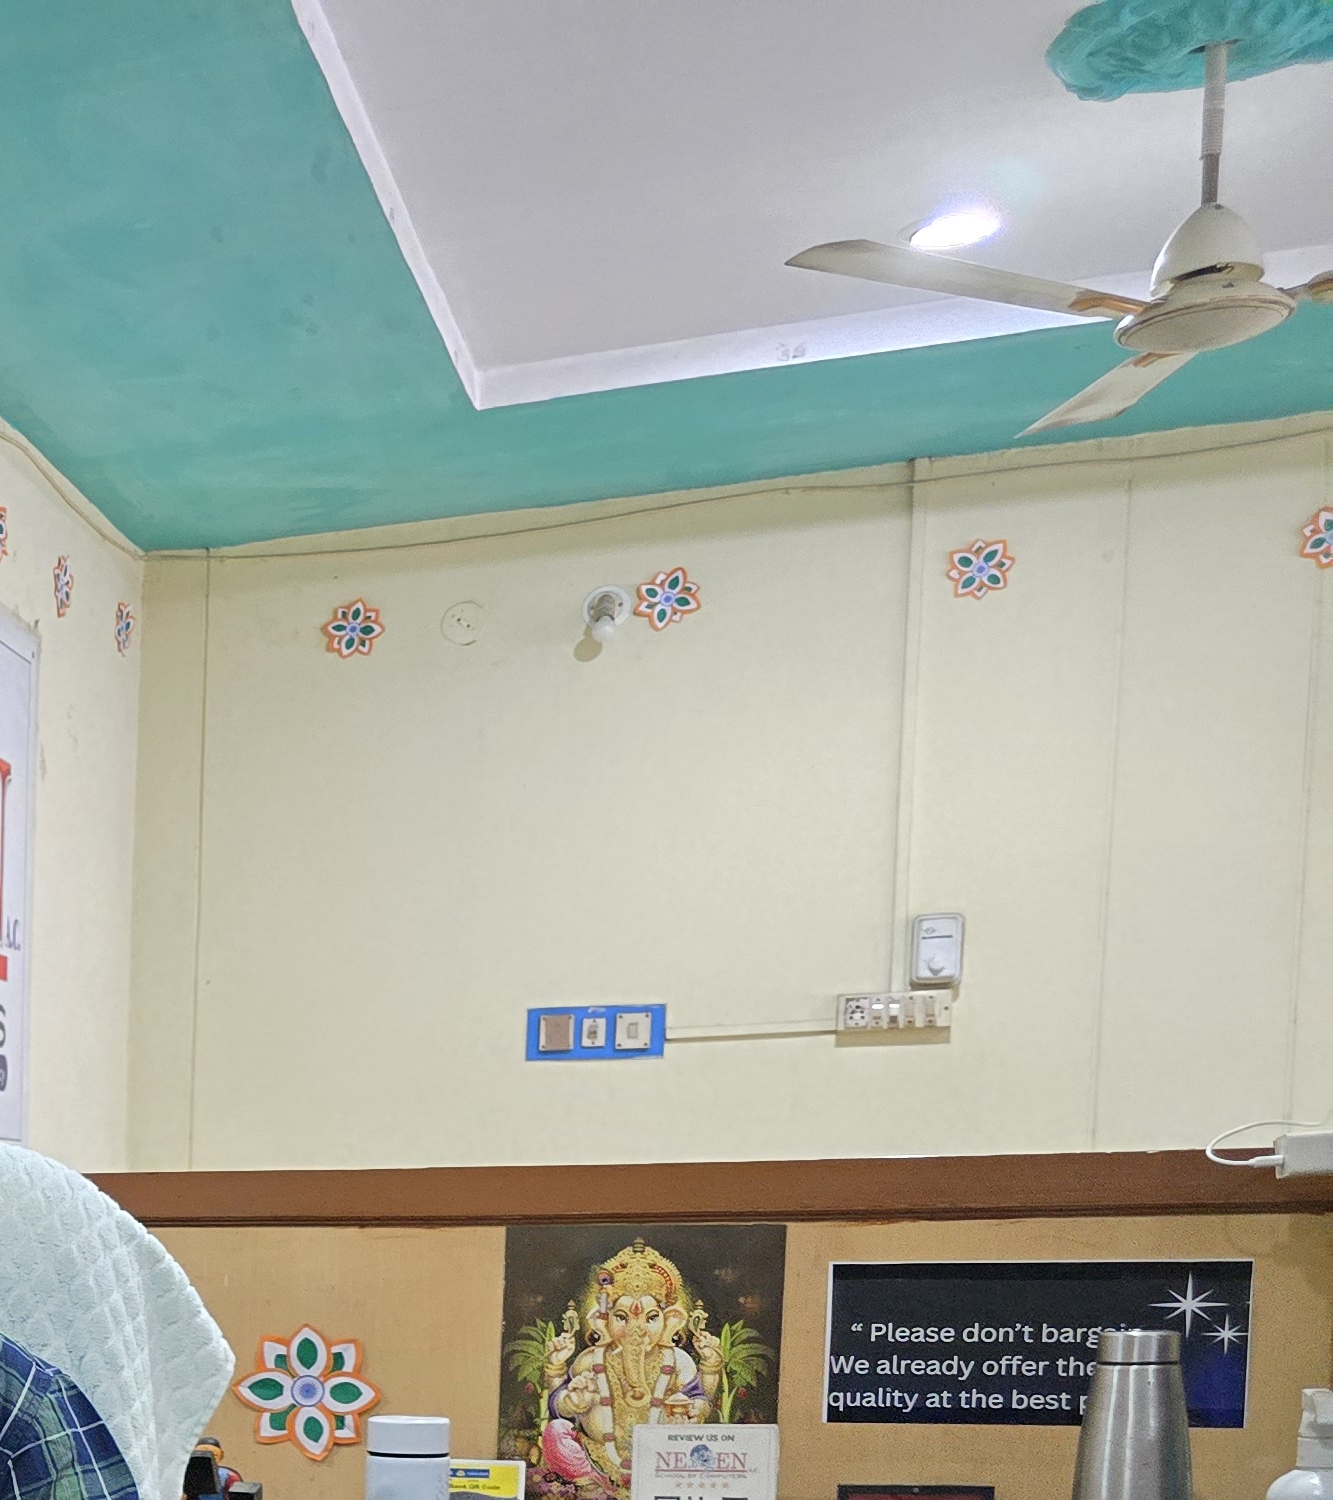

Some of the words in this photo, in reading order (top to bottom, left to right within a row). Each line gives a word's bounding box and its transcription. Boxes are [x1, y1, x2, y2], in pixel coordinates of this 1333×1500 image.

[870, 1322, 955, 1343] Please
[830, 1355, 870, 1375] We
[876, 1355, 975, 1381] already
[982, 1355, 1050, 1377] offer
[828, 1387, 918, 1412] quality
[925, 1389, 951, 1409] at
[959, 1388, 1004, 1409] the
[1011, 1388, 1071, 1410] best
[667, 1434, 704, 1442] REVIEW
[706, 1434, 719, 1442] US
[720, 1434, 735, 1442] ON
